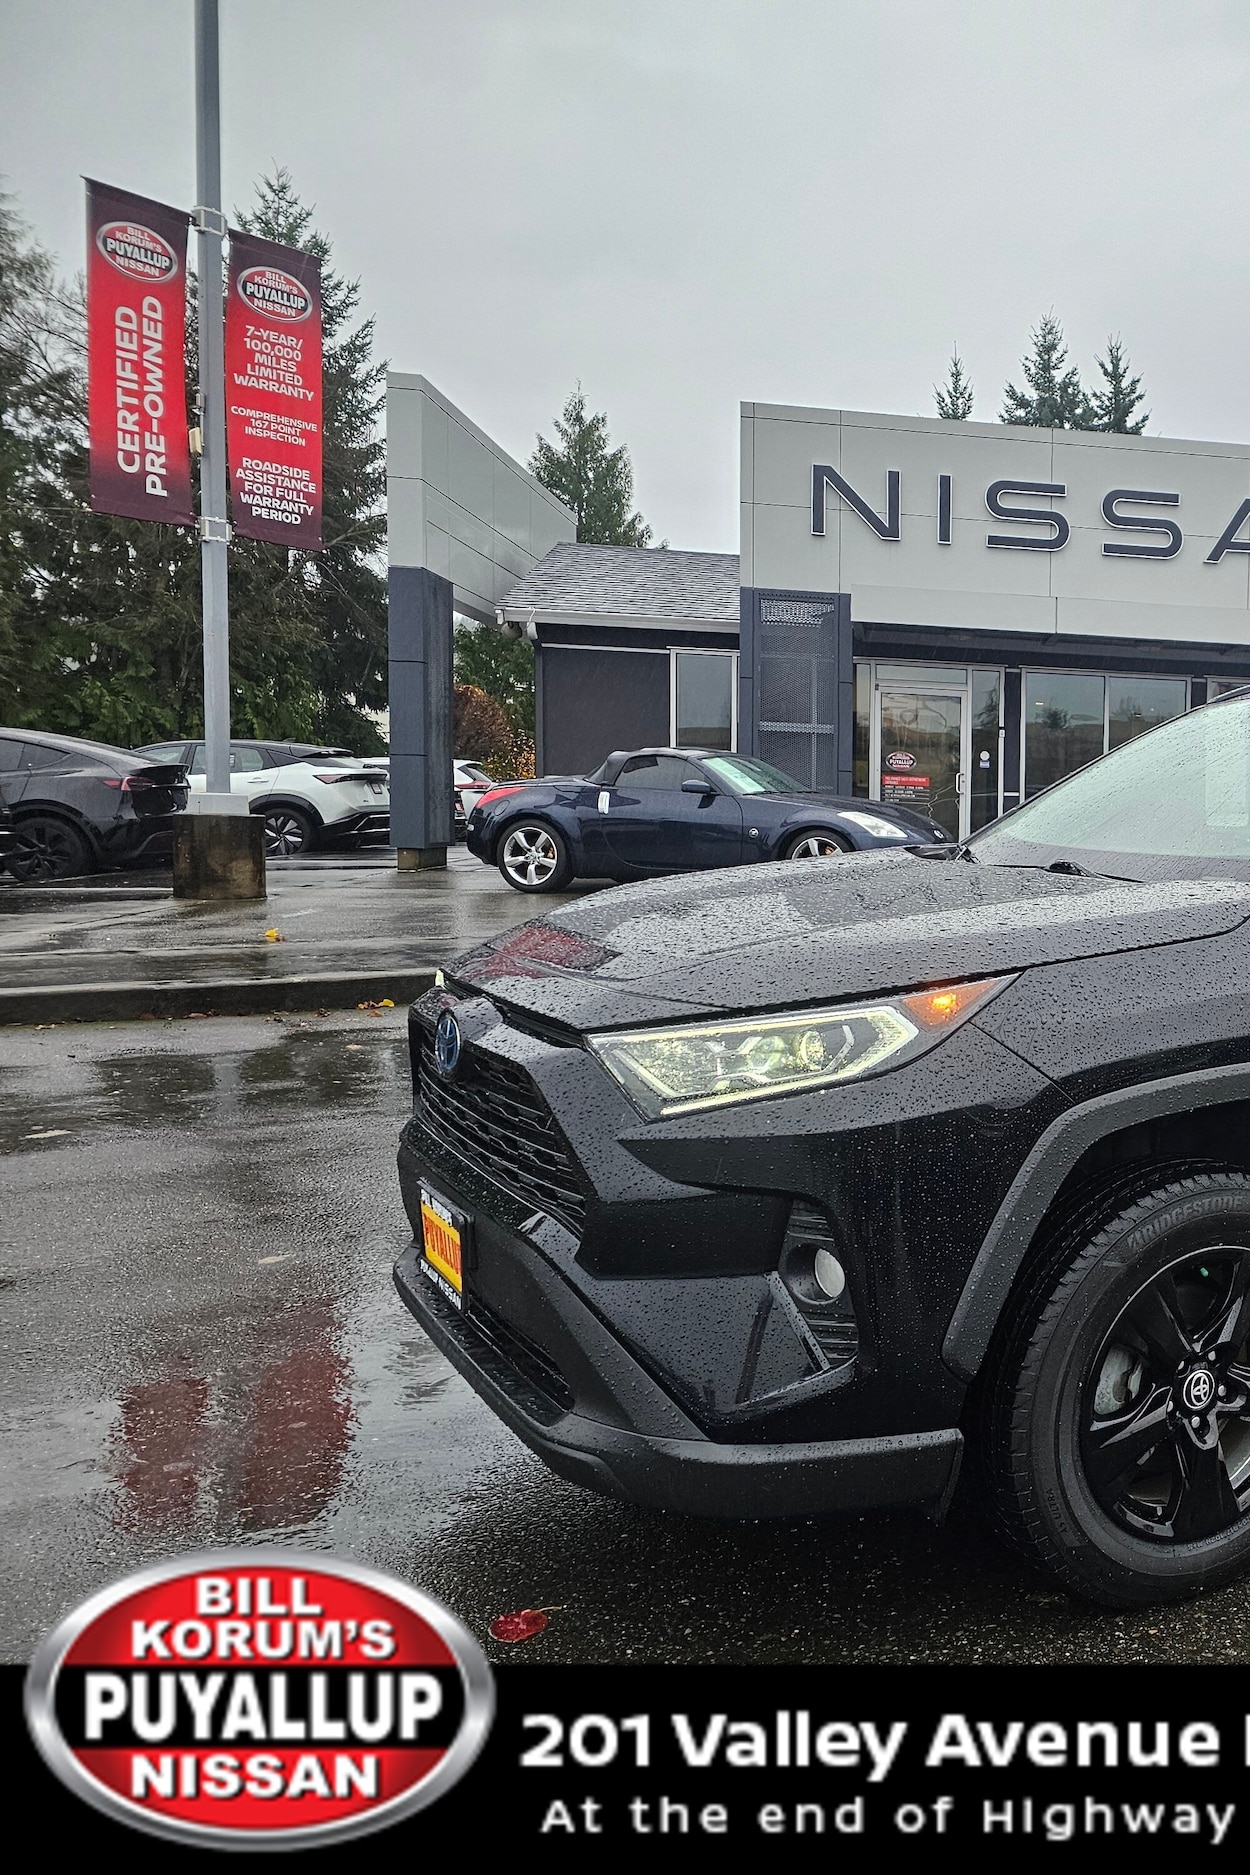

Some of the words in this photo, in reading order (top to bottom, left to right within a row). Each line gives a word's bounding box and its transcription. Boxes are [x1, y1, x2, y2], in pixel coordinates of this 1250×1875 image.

[115, 230, 162, 252] KORUM'S
[127, 226, 151, 241] BILL
[106, 238, 170, 269] PUYALLUP
[115, 255, 160, 276] NISSAN
[254, 275, 298, 294] KORUM'S
[265, 271, 287, 284] BILL
[246, 282, 306, 310] PUYALLUP
[254, 298, 296, 317] NISSAN
[245, 325, 303, 350] 7-YEAR/
[243, 338, 302, 361] 100,000
[254, 352, 297, 373] MILES
[247, 363, 303, 386] LIMITED
[115, 306, 141, 474] CERTIFIED
[142, 295, 168, 497] PRE-OWNED
[233, 373, 314, 401] WARRANTY
[230, 406, 318, 432] COMPREHENSIVE
[250, 418, 269, 429] 167
[270, 423, 302, 436] POINT
[245, 426, 306, 447] INSPECTION
[242, 457, 310, 480] ROADSIDE
[235, 468, 317, 493] ASSISTANCE
[244, 481, 274, 496] FOR
[275, 487, 307, 503] FULL
[240, 491, 314, 515] WARRANTY
[251, 506, 302, 525] PERIOD
